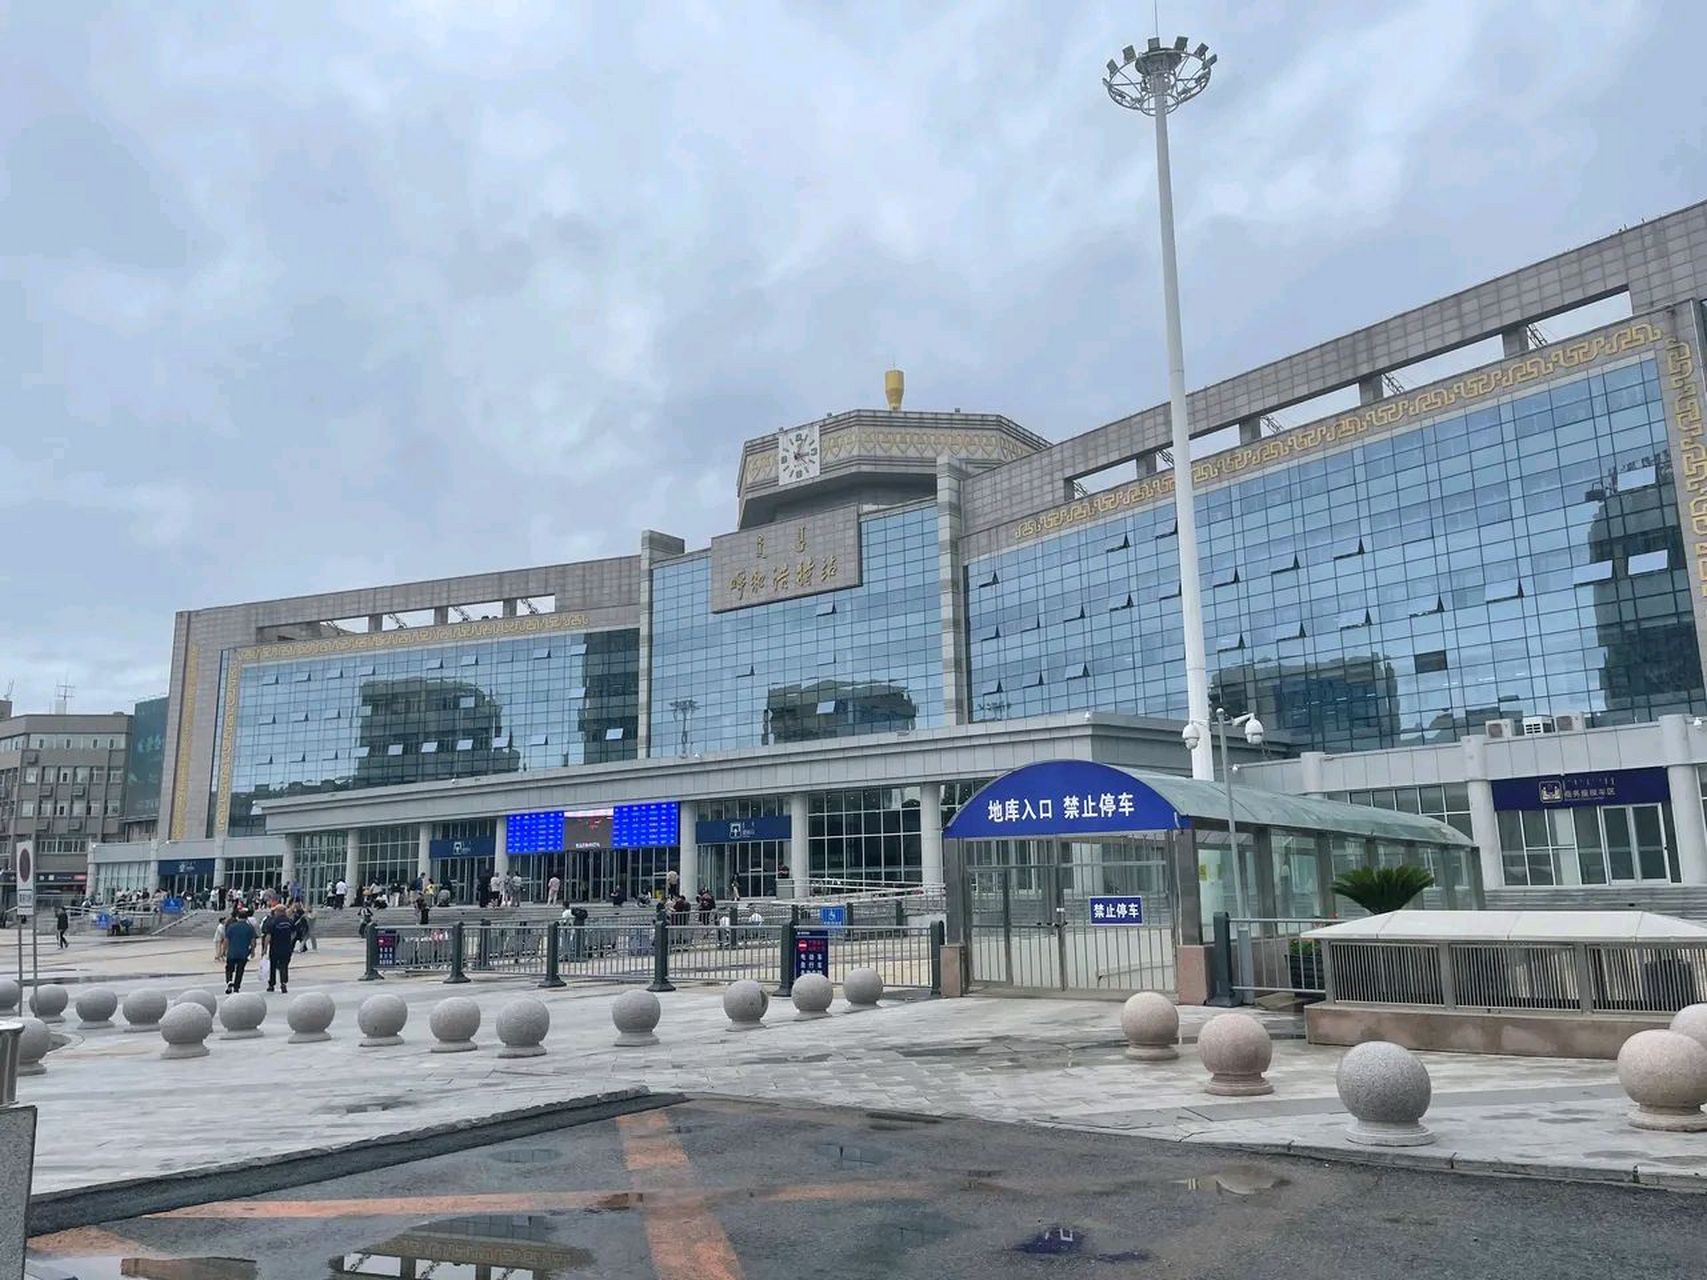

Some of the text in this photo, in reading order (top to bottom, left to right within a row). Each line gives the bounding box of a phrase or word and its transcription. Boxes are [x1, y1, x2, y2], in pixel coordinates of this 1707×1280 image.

[988, 792, 1135, 822] 地库入口 禁止停车
[1093, 903, 1139, 919] 禁止停车
